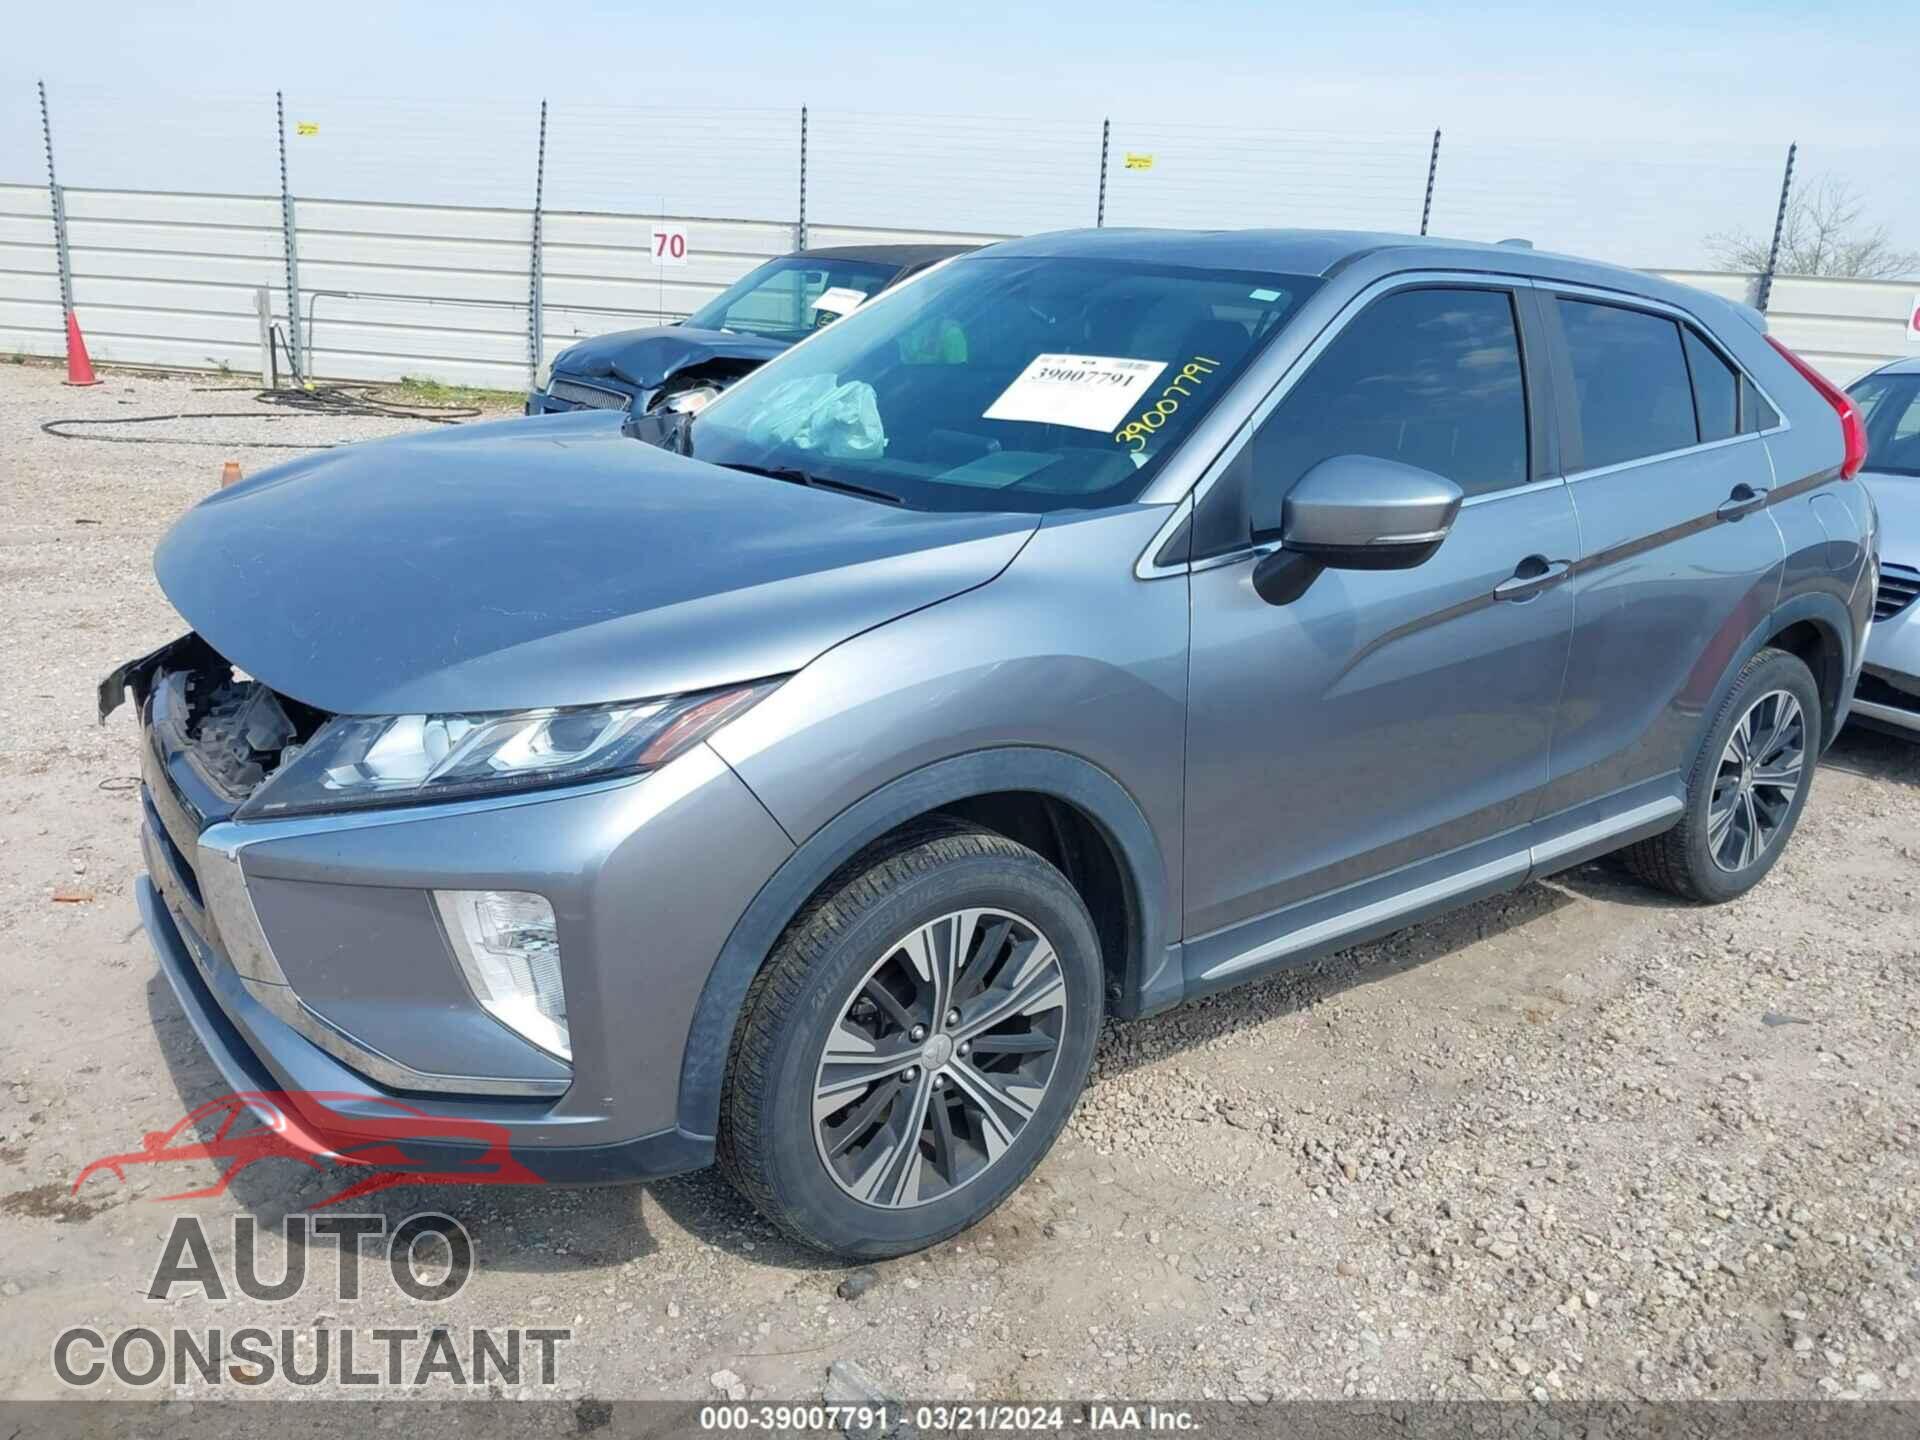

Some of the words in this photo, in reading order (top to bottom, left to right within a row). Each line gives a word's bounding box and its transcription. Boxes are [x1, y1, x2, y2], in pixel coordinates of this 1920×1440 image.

[653, 232, 685, 258] 70
[1031, 367, 1136, 387] 39007791
[1115, 356, 1220, 453] 39007791
